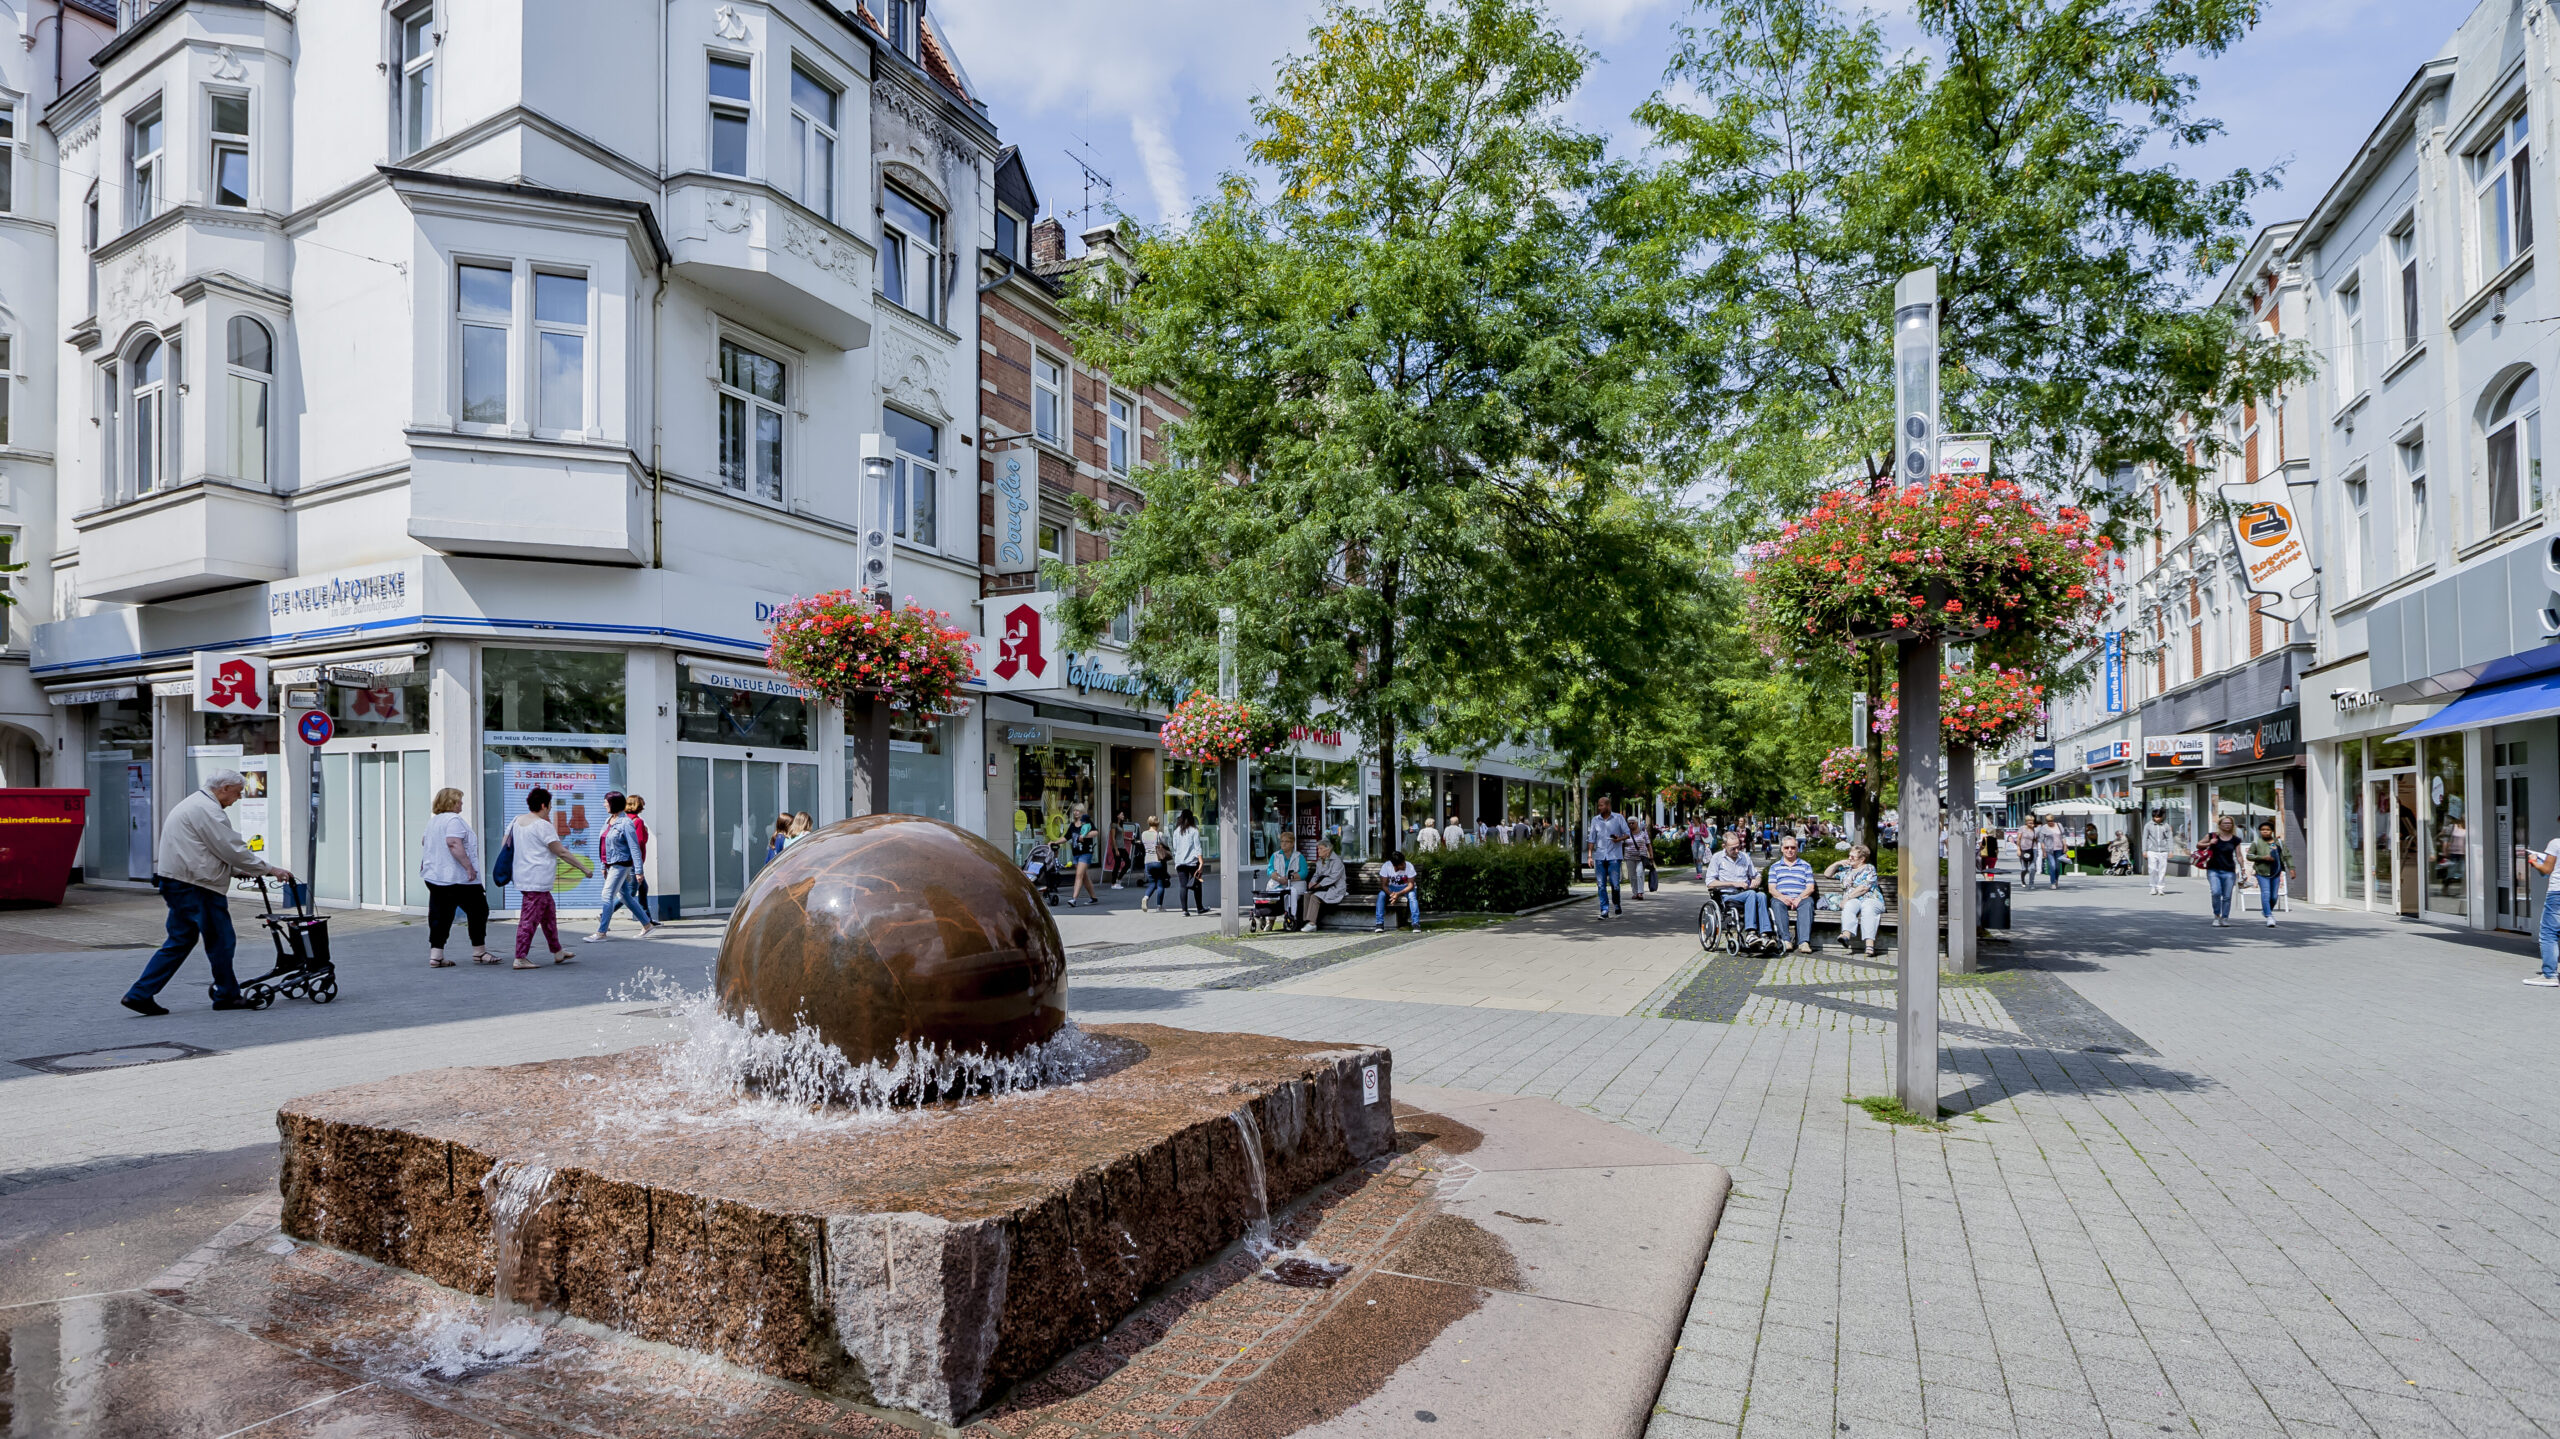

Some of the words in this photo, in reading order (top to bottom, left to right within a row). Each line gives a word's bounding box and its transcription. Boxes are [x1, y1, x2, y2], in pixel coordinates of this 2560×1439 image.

[997, 458, 1028, 564] Douglas
[2249, 540, 2299, 575] Rogosch
[2253, 551, 2302, 584] Textilpflege
[329, 572, 405, 604] APOTHEKE
[711, 675, 730, 687] DIE
[734, 678, 763, 692] NEUE
[1007, 727, 1041, 742] Douglas
[2261, 719, 2292, 746] HAKAN
[2179, 740, 2203, 749] Nails
[514, 770, 521, 778] 3
[525, 769, 597, 780] Saftflaschen
[514, 782, 530, 790] für
